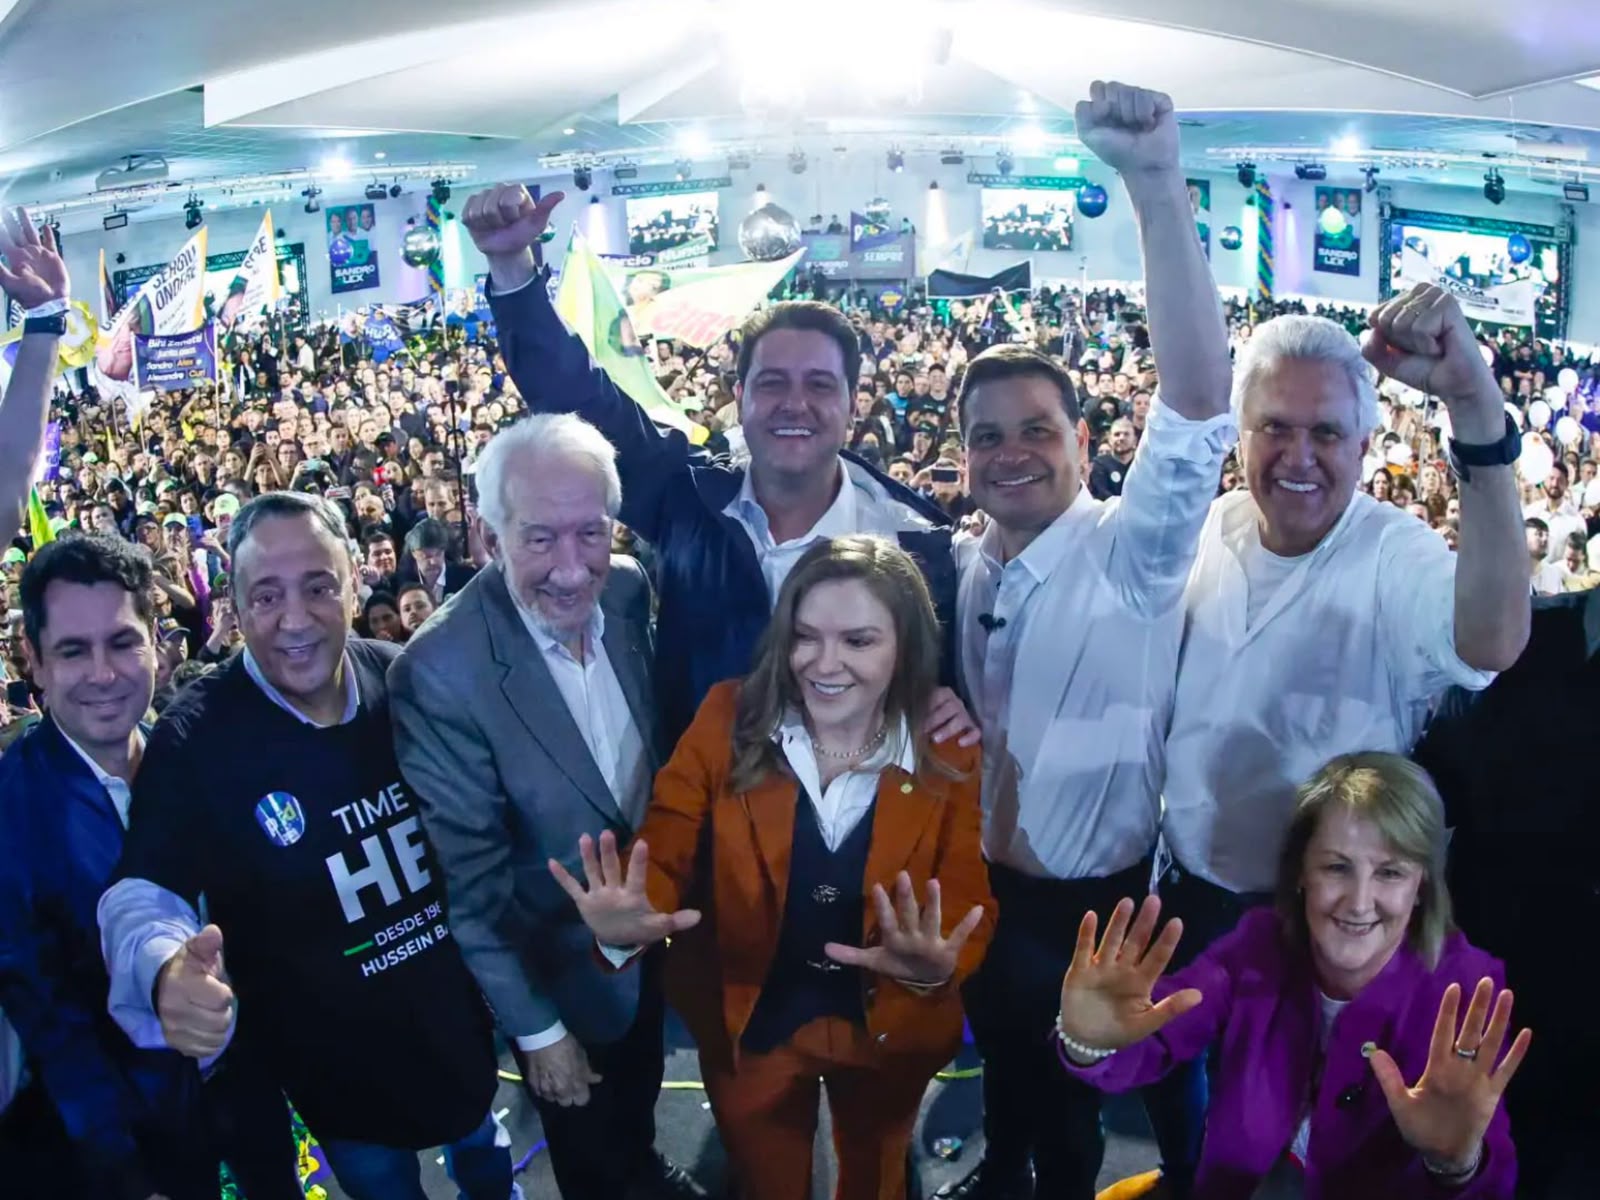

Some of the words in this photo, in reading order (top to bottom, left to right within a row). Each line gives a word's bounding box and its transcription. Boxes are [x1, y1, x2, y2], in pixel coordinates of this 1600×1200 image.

[331, 782, 409, 835] TIME
[374, 913, 424, 946] DESDE
[361, 931, 433, 977] HUSSEIN
